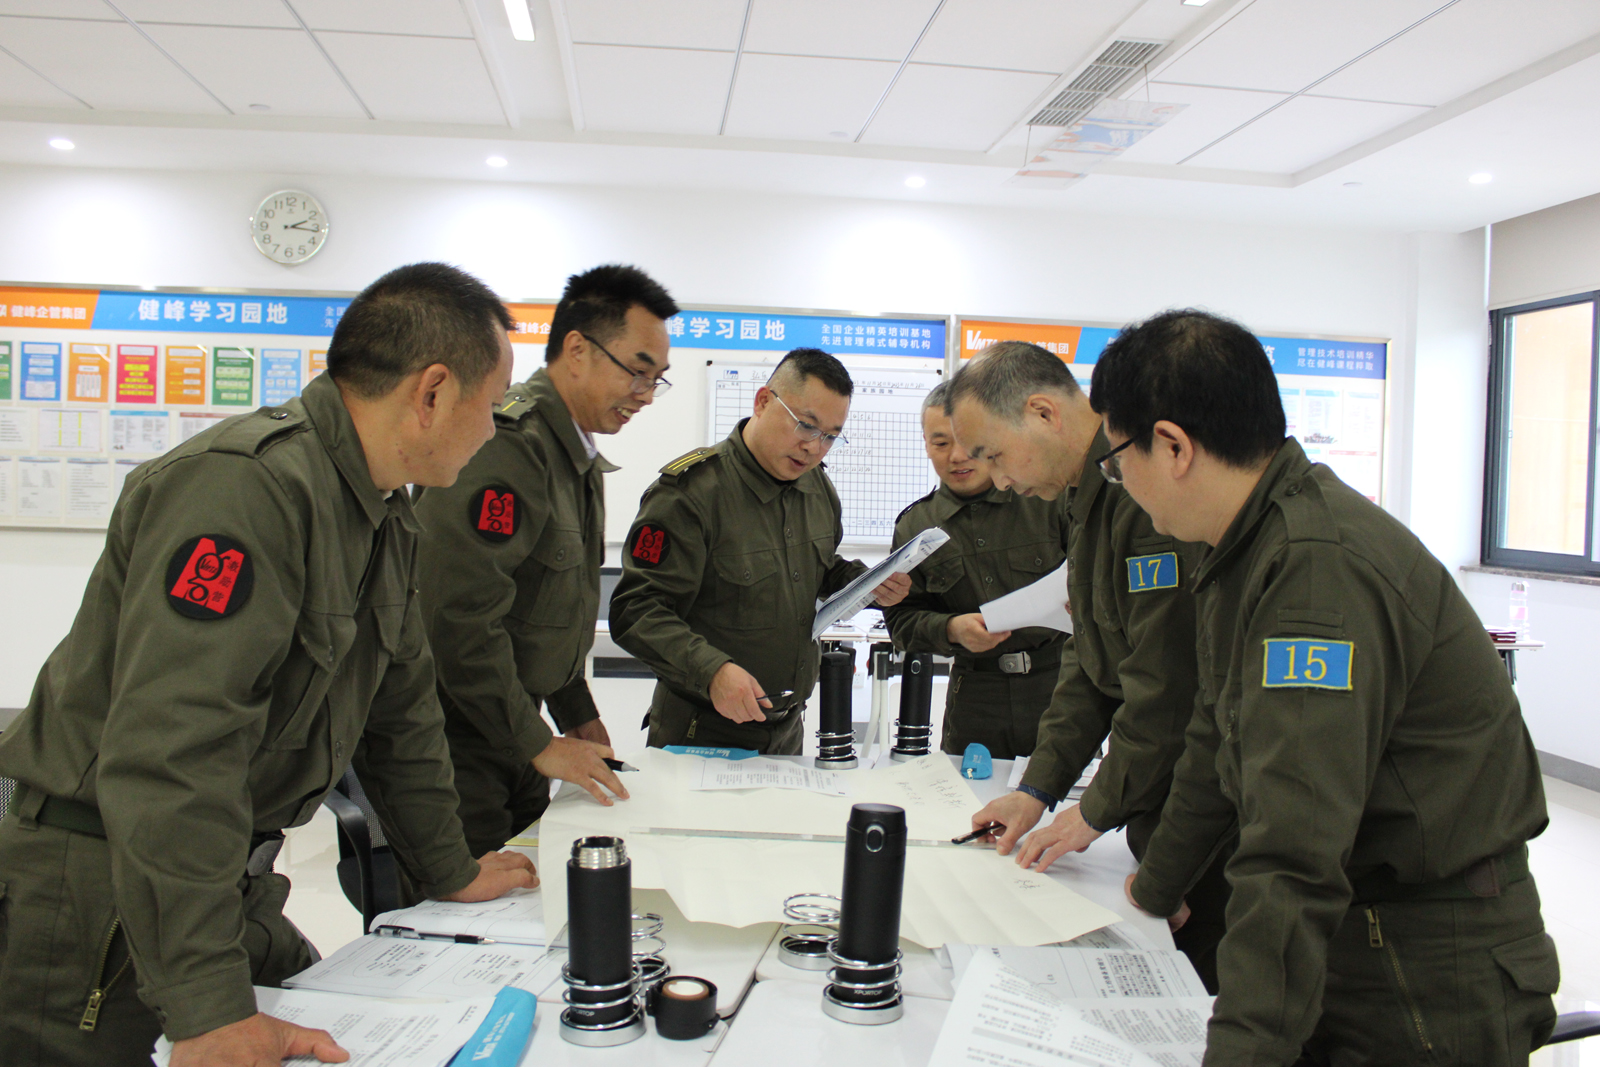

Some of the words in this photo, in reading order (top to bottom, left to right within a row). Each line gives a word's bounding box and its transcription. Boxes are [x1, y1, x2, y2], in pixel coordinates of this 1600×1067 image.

[275, 200, 283, 210] 11
[286, 197, 297, 207] 12
[264, 209, 275, 219] 10
[308, 211, 317, 220] 2
[259, 221, 269, 231] 9
[311, 223, 319, 233] 3
[262, 234, 271, 244] 8
[308, 236, 316, 245] 4
[272, 244, 280, 254] 7
[284, 247, 293, 258] 6
[297, 245, 306, 255] 5
[138, 298, 288, 324] 健峰学习园地
[664, 316, 786, 341] 峰学习园地
[821, 324, 931, 338] 全国企业精英培训基地
[821, 336, 931, 350] 先进管理模式辅导机构
[1297, 347, 1374, 360] 管理技术培训精华
[1136, 559, 1161, 586] 17
[1283, 645, 1329, 681] 15
